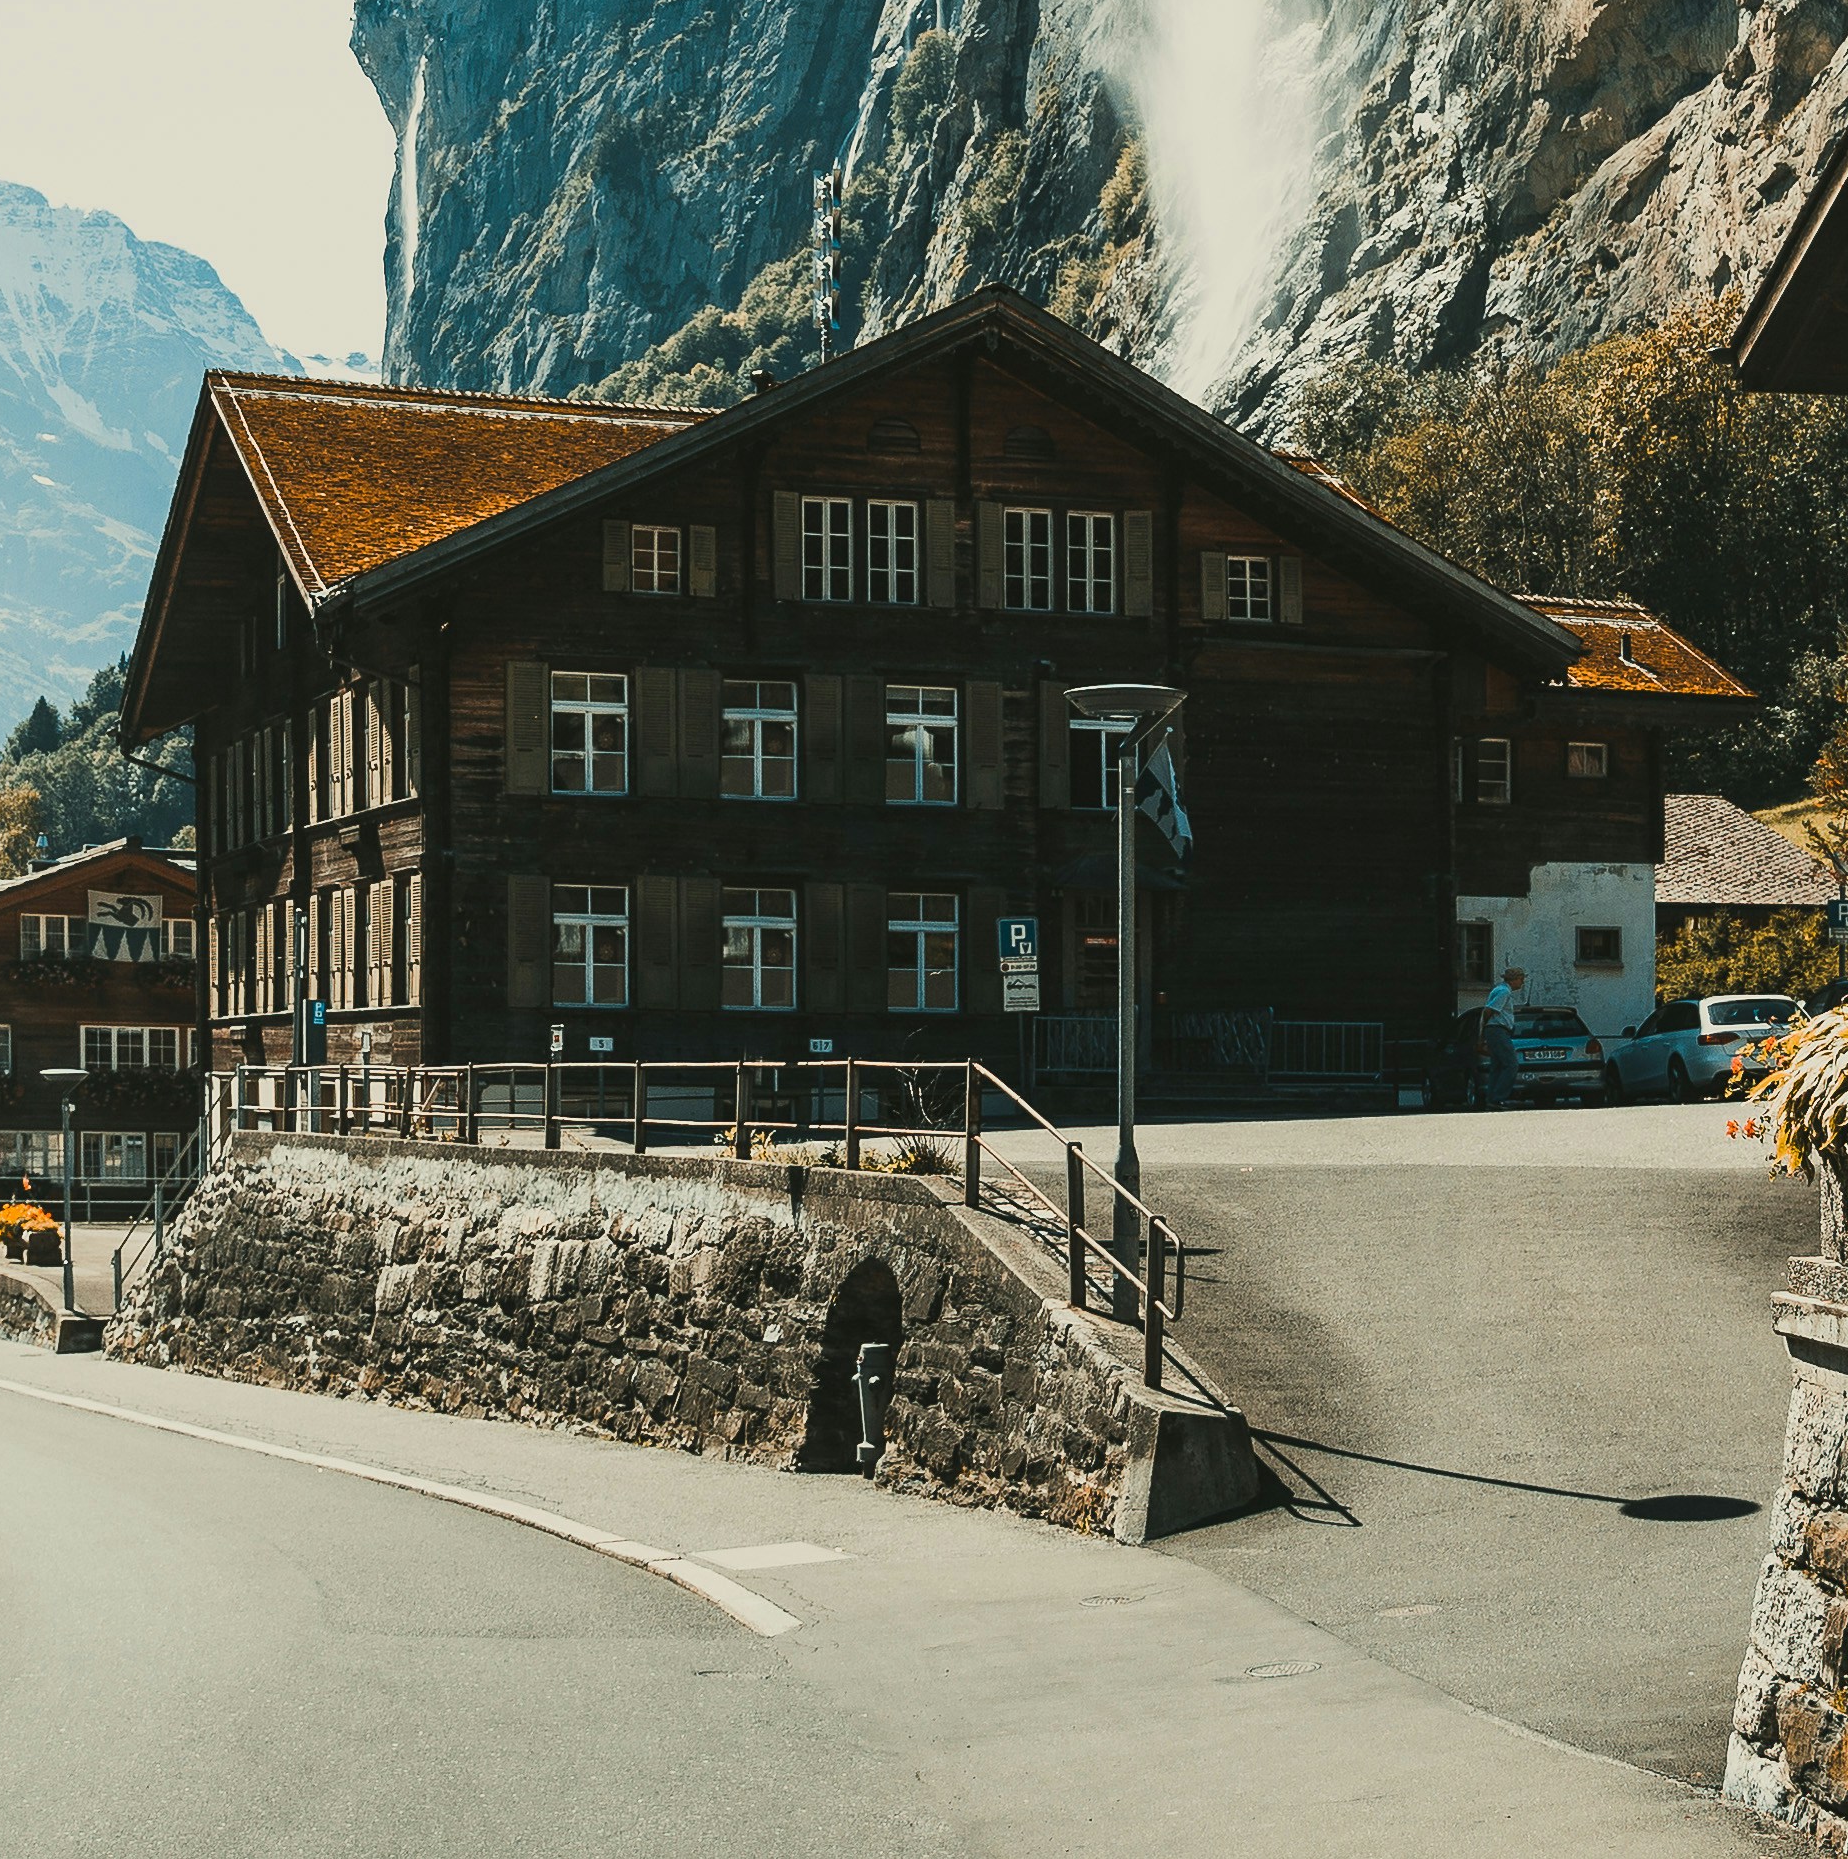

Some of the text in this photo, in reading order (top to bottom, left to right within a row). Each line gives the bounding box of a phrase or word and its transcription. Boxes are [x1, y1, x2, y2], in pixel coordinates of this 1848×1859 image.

[1010, 924, 1026, 948] P
[315, 1002, 322, 1011] P
[599, 1040, 605, 1048] 5
